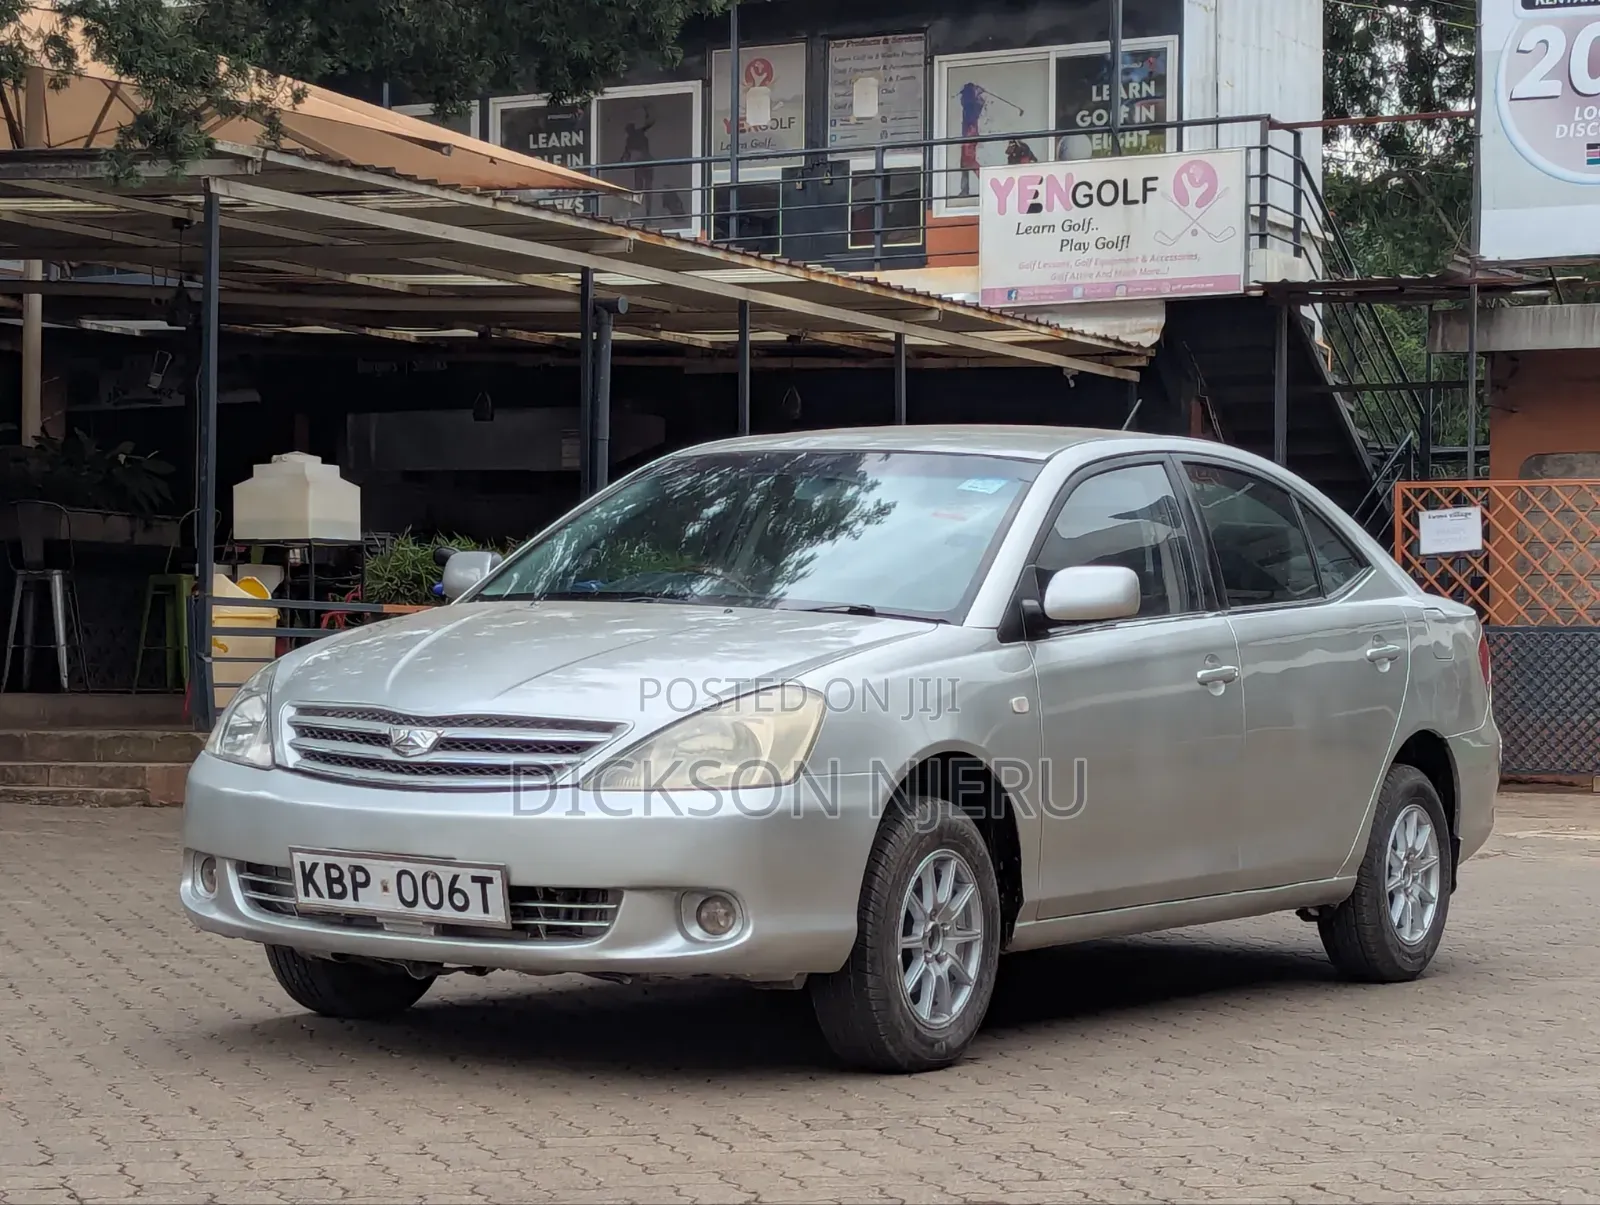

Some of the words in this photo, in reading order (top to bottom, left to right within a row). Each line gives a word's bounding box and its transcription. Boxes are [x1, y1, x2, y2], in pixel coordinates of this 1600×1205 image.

[1091, 81, 1156, 102] LEARN
[1075, 104, 1130, 127] GOF
[1134, 104, 1156, 124] IN
[1574, 105, 1600, 122] LO
[528, 130, 584, 149] LEARN
[1555, 121, 1600, 140] DISC
[566, 152, 584, 167] IN
[1015, 222, 1055, 236] Learn
[1059, 237, 1090, 253] Play
[1095, 235, 1131, 251] Golf!
[299, 860, 371, 902] KBP
[396, 869, 495, 915] 006T
